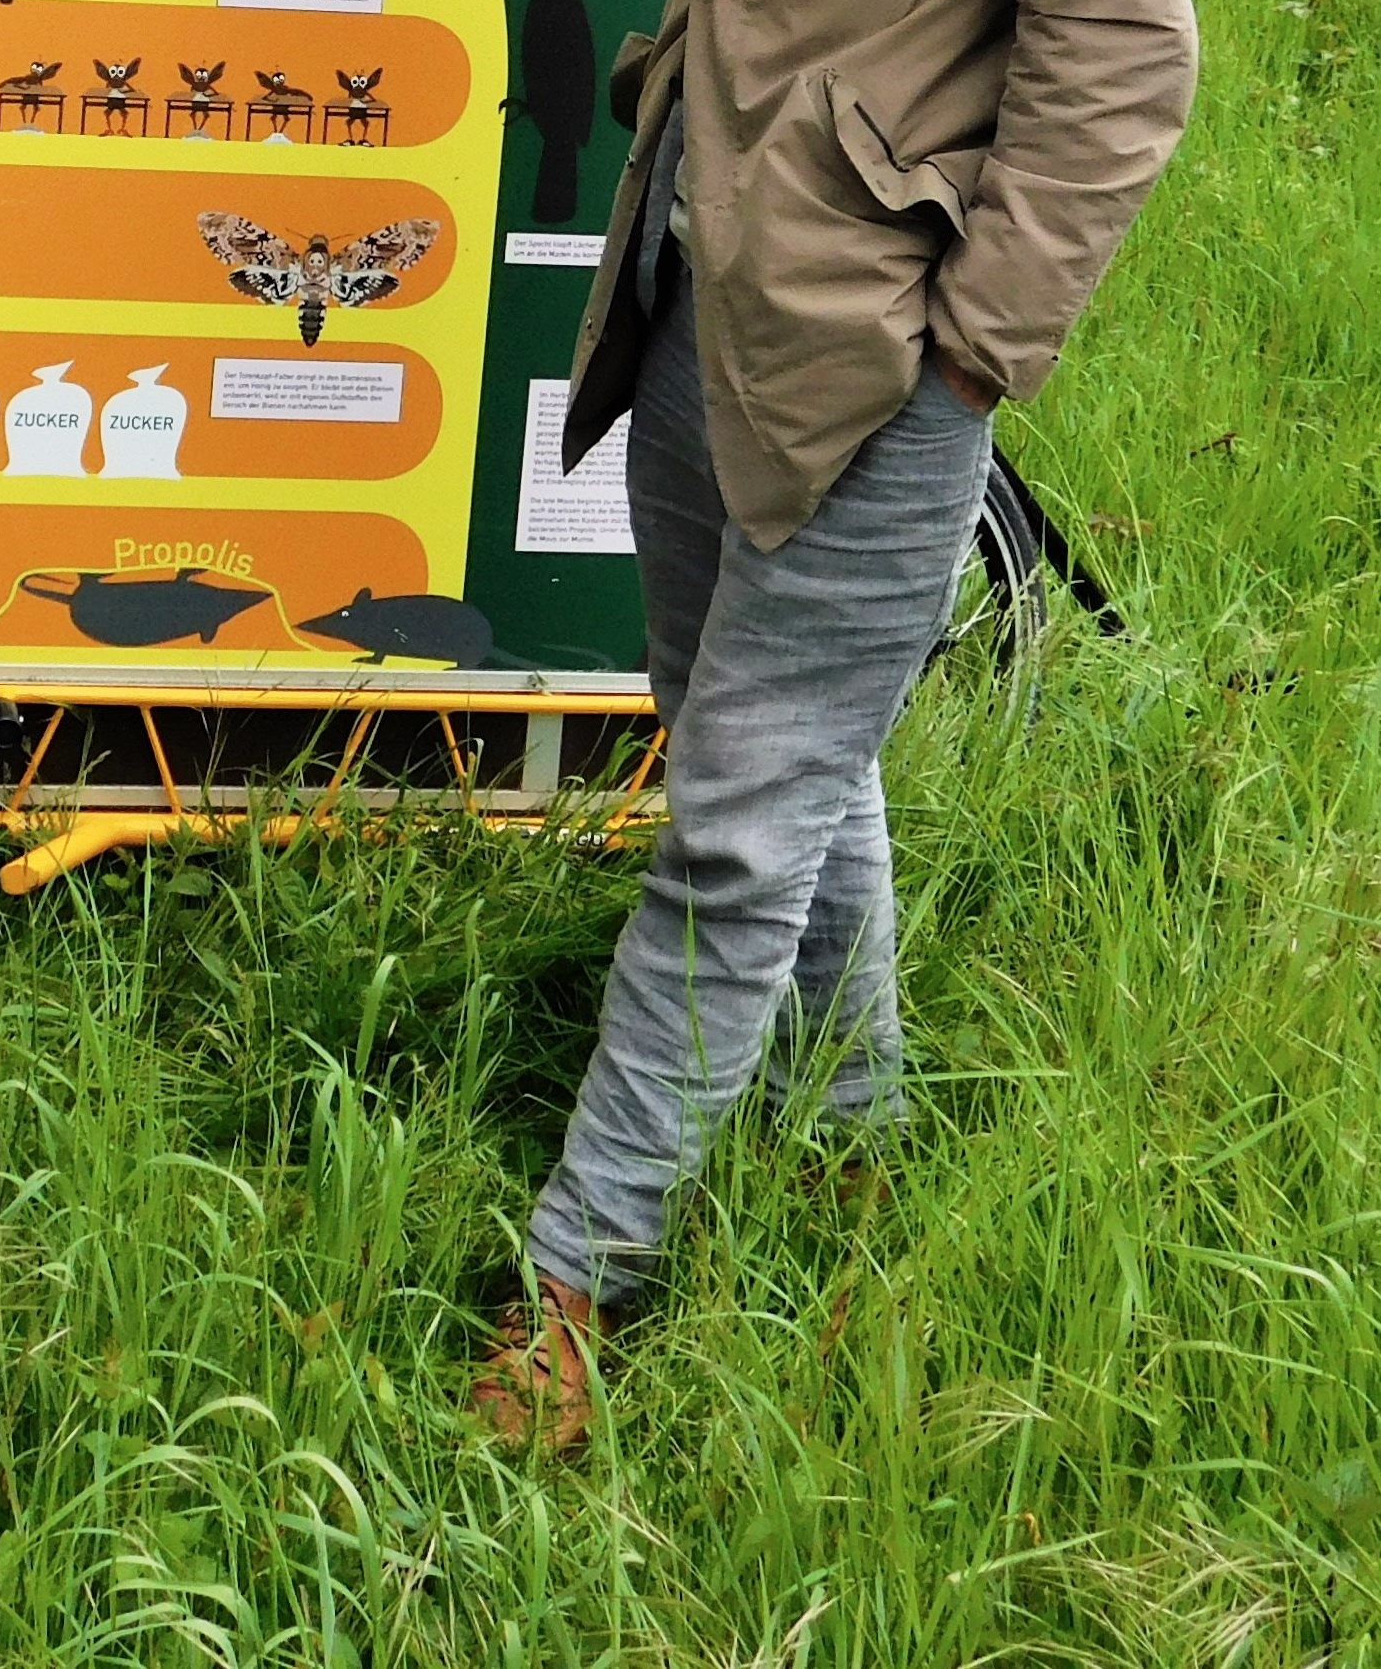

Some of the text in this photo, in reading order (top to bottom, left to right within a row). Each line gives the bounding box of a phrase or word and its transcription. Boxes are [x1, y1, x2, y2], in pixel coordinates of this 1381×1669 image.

[14, 412, 79, 428] ZUCKER
[110, 415, 174, 431] ZUCKER
[114, 537, 254, 576] Propolis
